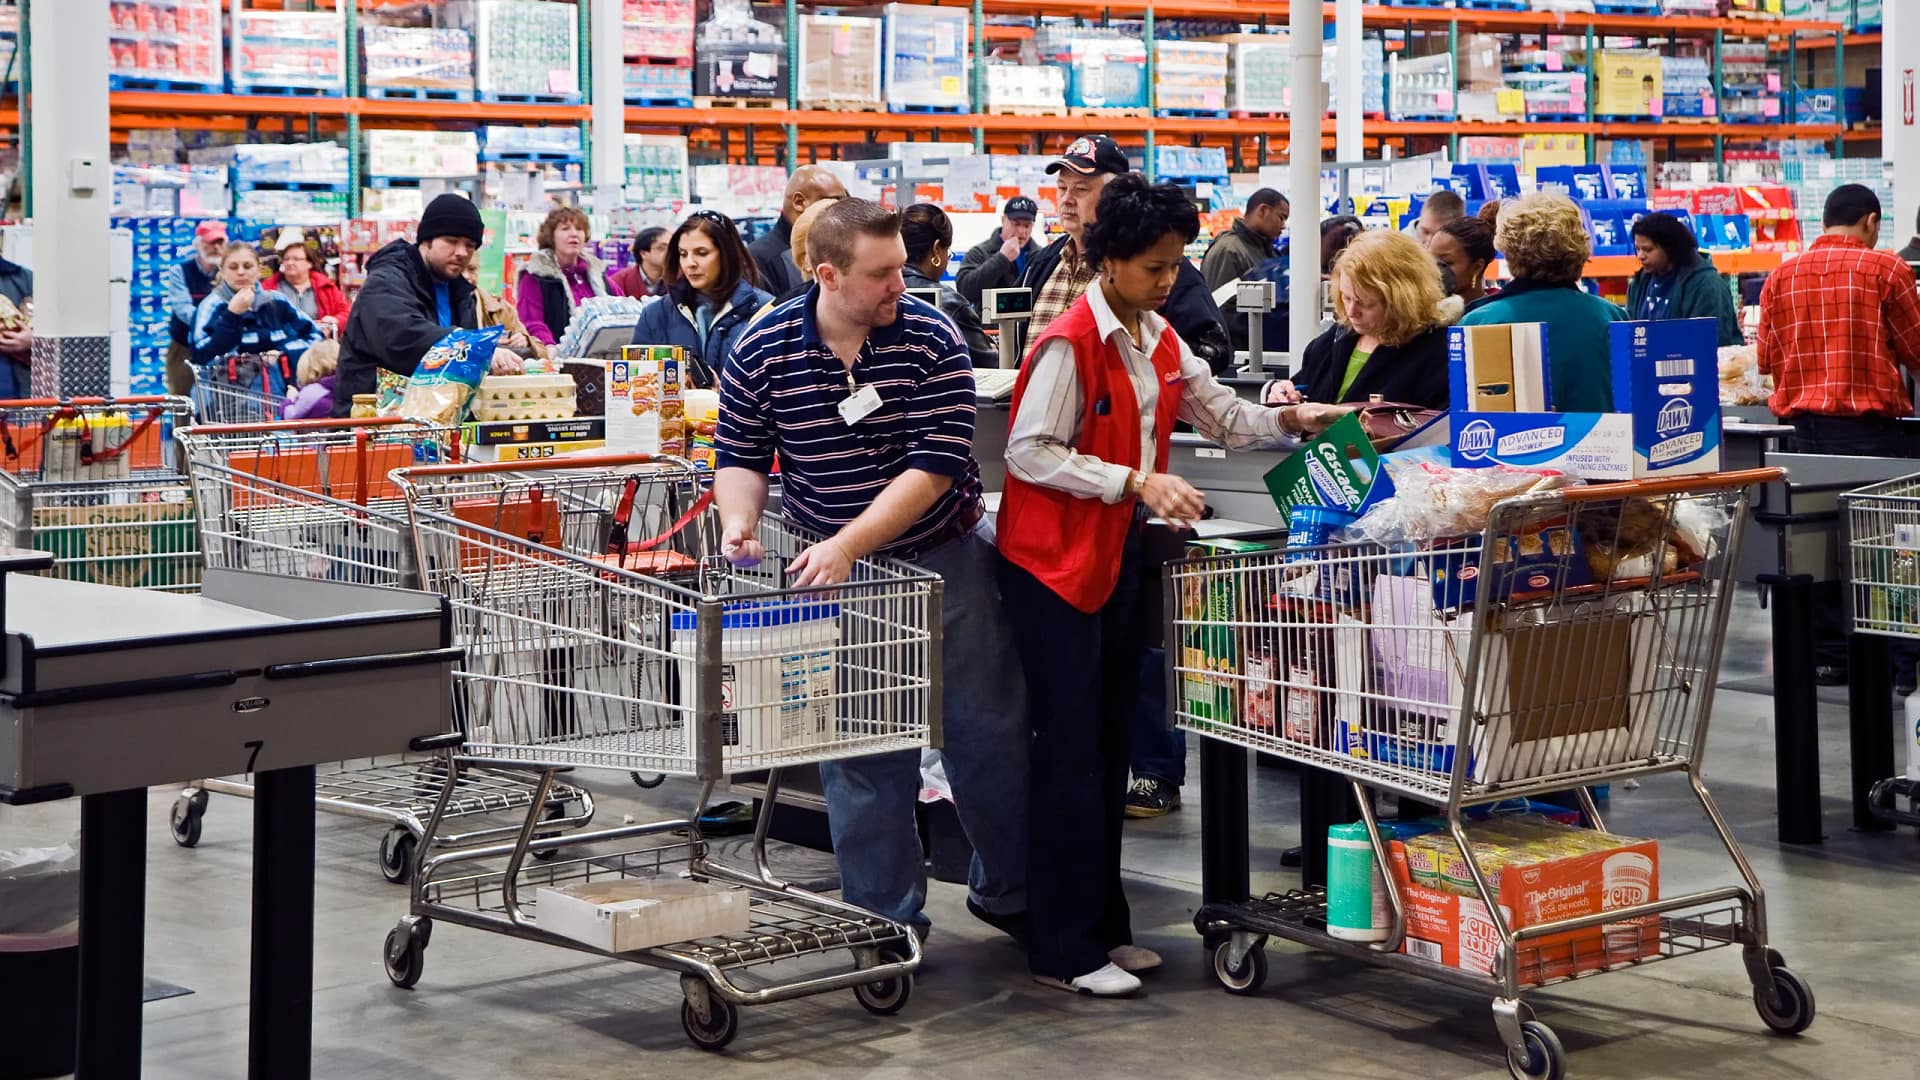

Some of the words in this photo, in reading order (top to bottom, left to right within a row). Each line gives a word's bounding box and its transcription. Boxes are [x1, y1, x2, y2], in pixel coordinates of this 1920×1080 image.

[1634, 326, 1646, 337] 90
[1656, 406, 1693, 433] DAWN
[1458, 428, 1496, 452] DAWN
[1499, 428, 1562, 448] ADVANCED
[1517, 442, 1543, 451] POWER
[1651, 433, 1702, 457] ADVANCED
[1565, 454, 1593, 462] INFUSED
[1593, 455, 1611, 463] WITH
[1665, 447, 1687, 456] POWER
[1318, 442, 1361, 505] Cascade
[1598, 463, 1628, 471] ENZYMES
[1311, 461, 1344, 504] ADVANCED
[244, 740, 264, 773] 7
[1558, 902, 1569, 911] the
[1610, 887, 1643, 906] CUP
[1467, 917, 1500, 941] CUP
